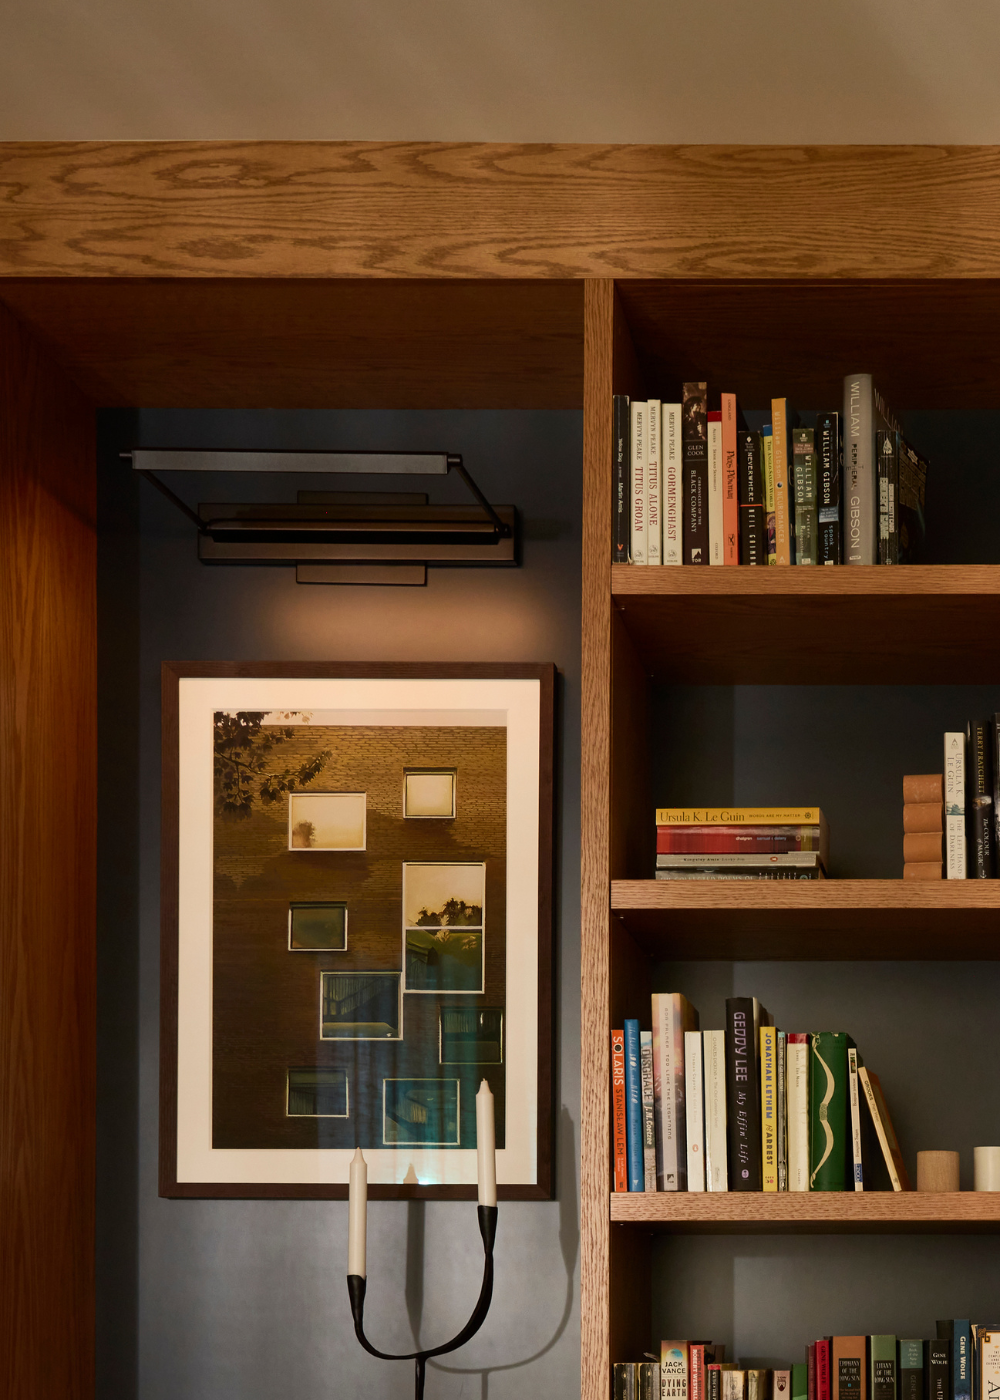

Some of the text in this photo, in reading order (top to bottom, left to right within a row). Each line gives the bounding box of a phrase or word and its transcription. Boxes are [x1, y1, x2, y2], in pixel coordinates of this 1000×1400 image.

[851, 382, 860, 437] WILLIAM
[635, 467, 643, 531] TITUS GROAN
[649, 461, 657, 525] TITUS ALONE
[668, 467, 676, 540] GORMENGHAST
[851, 496, 860, 548] GIBSON
[660, 812, 745, 822] Ursula K. Le Guin
[734, 1012, 748, 1163] GEDDY LEE My Effin' Life
[662, 1379, 686, 1387] DYING
